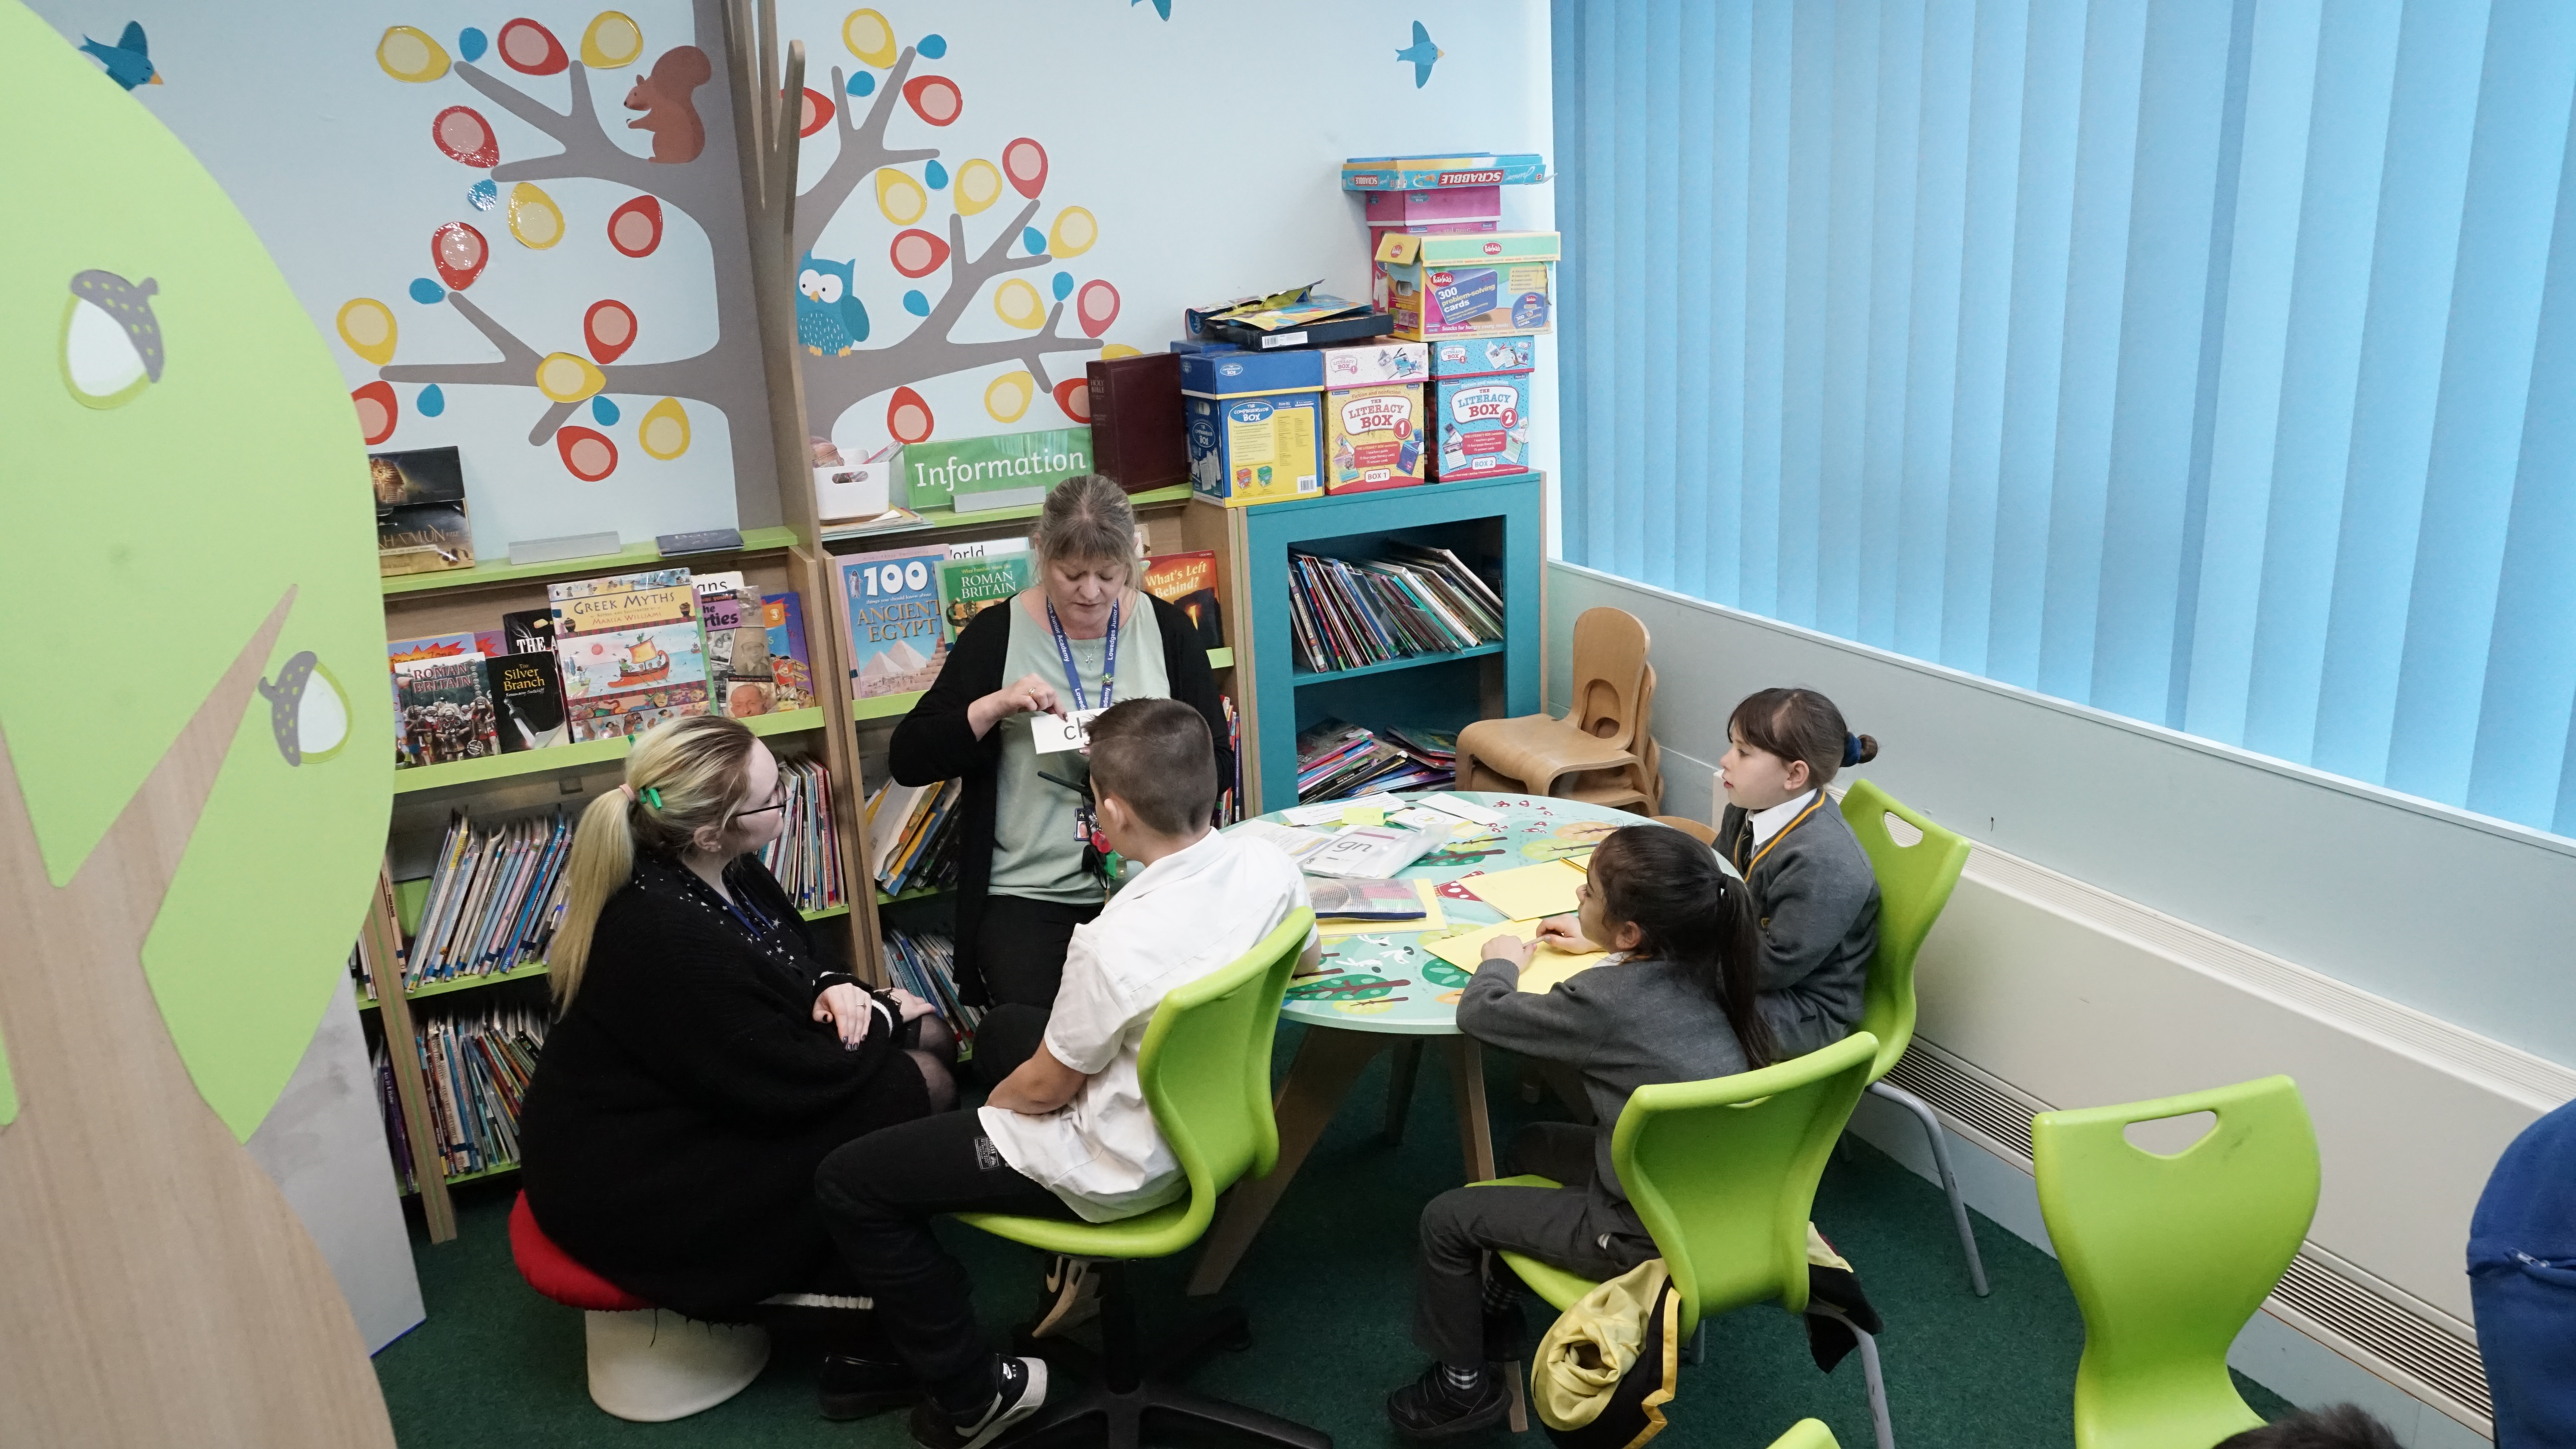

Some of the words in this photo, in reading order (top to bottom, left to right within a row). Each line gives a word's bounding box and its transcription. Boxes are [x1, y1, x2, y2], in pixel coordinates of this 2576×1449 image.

[1441, 172, 1501, 184] SCRABBLE
[1433, 275, 1452, 283] BrainSnack
[1438, 287, 1458, 300] 300
[1442, 284, 1495, 307] problem-solving
[1444, 300, 1470, 312] cards
[1458, 394, 1511, 408] LITERACY
[1243, 413, 1260, 421] BOX
[1349, 404, 1404, 419] LITERACY
[1468, 404, 1500, 418] BOX
[1505, 412, 1513, 424] 2
[1360, 415, 1393, 429] BOX
[1399, 422, 1404, 435] 1
[1200, 436, 1209, 446] BOX
[915, 449, 1086, 492] Information
[951, 545, 984, 559] orld
[864, 561, 928, 596] 100
[961, 571, 1013, 587] ROMAN
[1145, 570, 1183, 586] What's
[1186, 561, 1207, 576] Left
[962, 582, 1016, 599] BRITAIN
[1154, 576, 1199, 598] Behind?
[574, 600, 617, 615] GREEK
[624, 592, 674, 608] MYTHS
[624, 612, 662, 621] WILLIAMS
[857, 600, 940, 625] ANCIENT
[868, 618, 937, 642] EGYPT
[516, 637, 546, 654] THE
[1051, 615, 1061, 634] Junior
[1057, 634, 1069, 662] Academy
[1107, 629, 1117, 660] Lowedges
[413, 663, 468, 680] ROMAN
[504, 668, 538, 680] Silver
[413, 675, 472, 693] BRITAIN
[503, 676, 545, 691] Branch
[1332, 841, 1373, 852] gn
[386, 894, 396, 917] PHARAOHS
